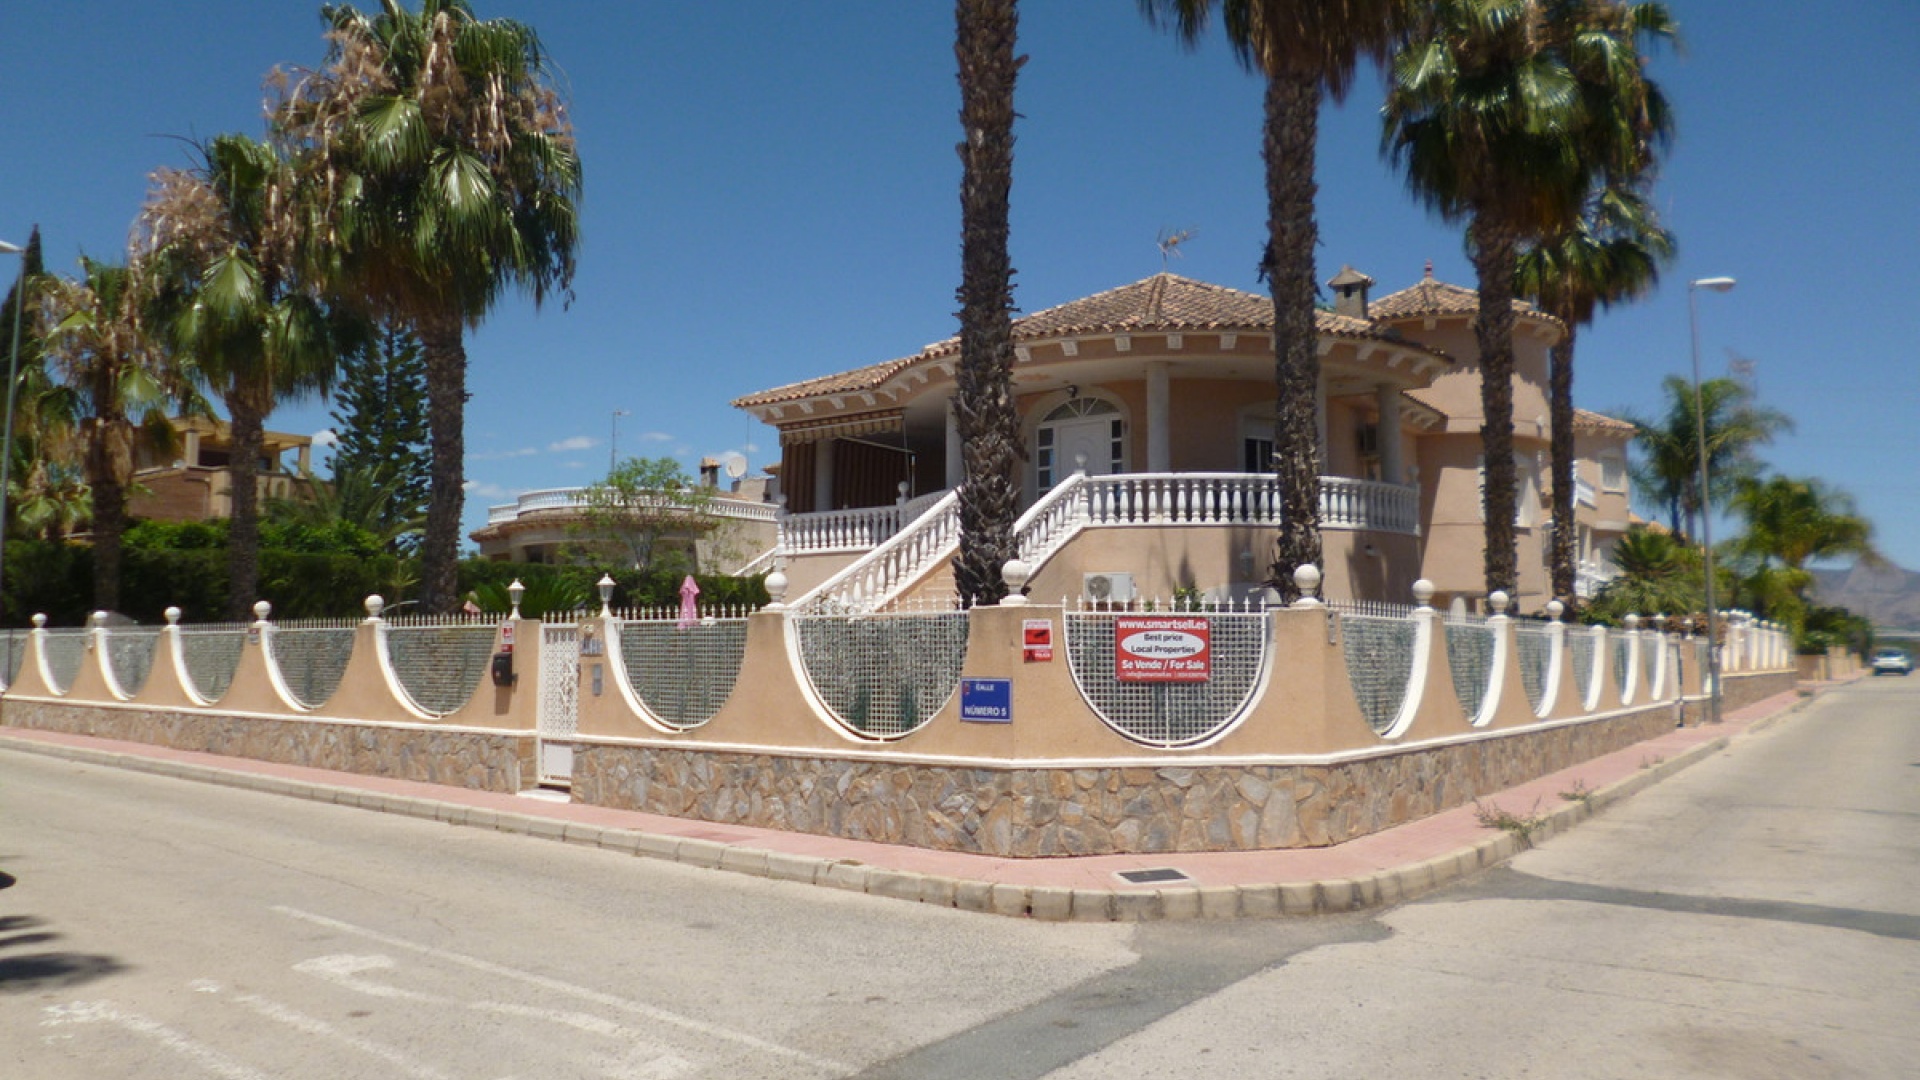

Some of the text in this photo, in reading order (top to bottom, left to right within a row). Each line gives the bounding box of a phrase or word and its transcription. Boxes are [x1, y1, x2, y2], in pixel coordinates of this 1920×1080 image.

[1119, 619, 1207, 630] www.smartsell.es
[1163, 634, 1183, 643] price
[1154, 645, 1196, 654] Properties
[1122, 660, 1205, 670] Se Vende / For Sale
[976, 683, 994, 691] CALLE
[965, 705, 1000, 716] NÚMERO
